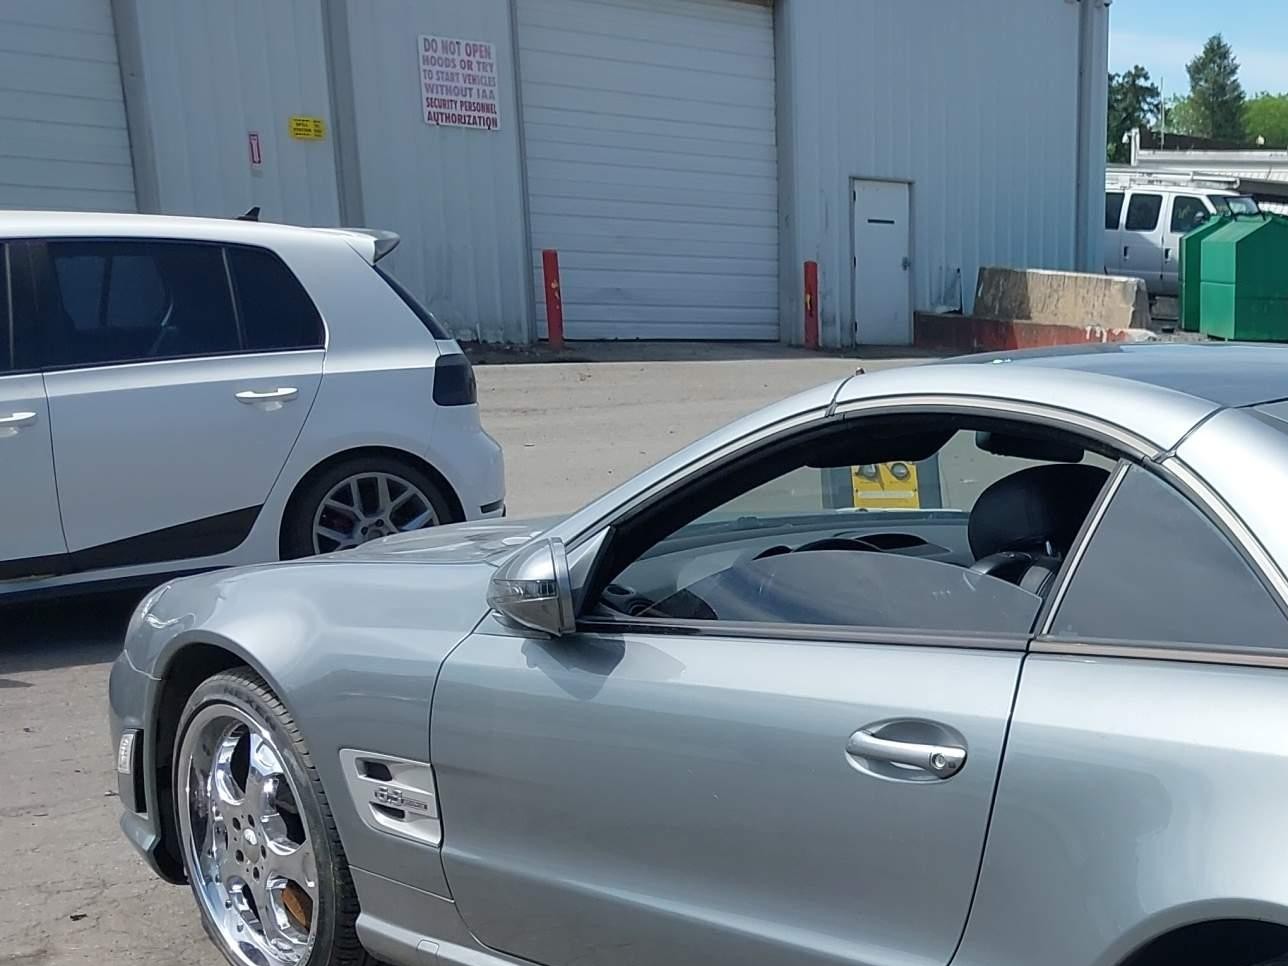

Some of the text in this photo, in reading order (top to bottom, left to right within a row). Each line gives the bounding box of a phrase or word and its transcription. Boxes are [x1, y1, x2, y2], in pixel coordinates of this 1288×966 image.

[423, 38, 491, 59] DO NOT OPEN
[422, 55, 494, 72] HOODS OR TRY
[423, 69, 496, 87] TO START VEHICLES
[424, 83, 496, 100] WITHOUT IAA
[426, 97, 497, 115] SECURITY PERSONNEL
[427, 111, 498, 129] AUTHORIZATION
